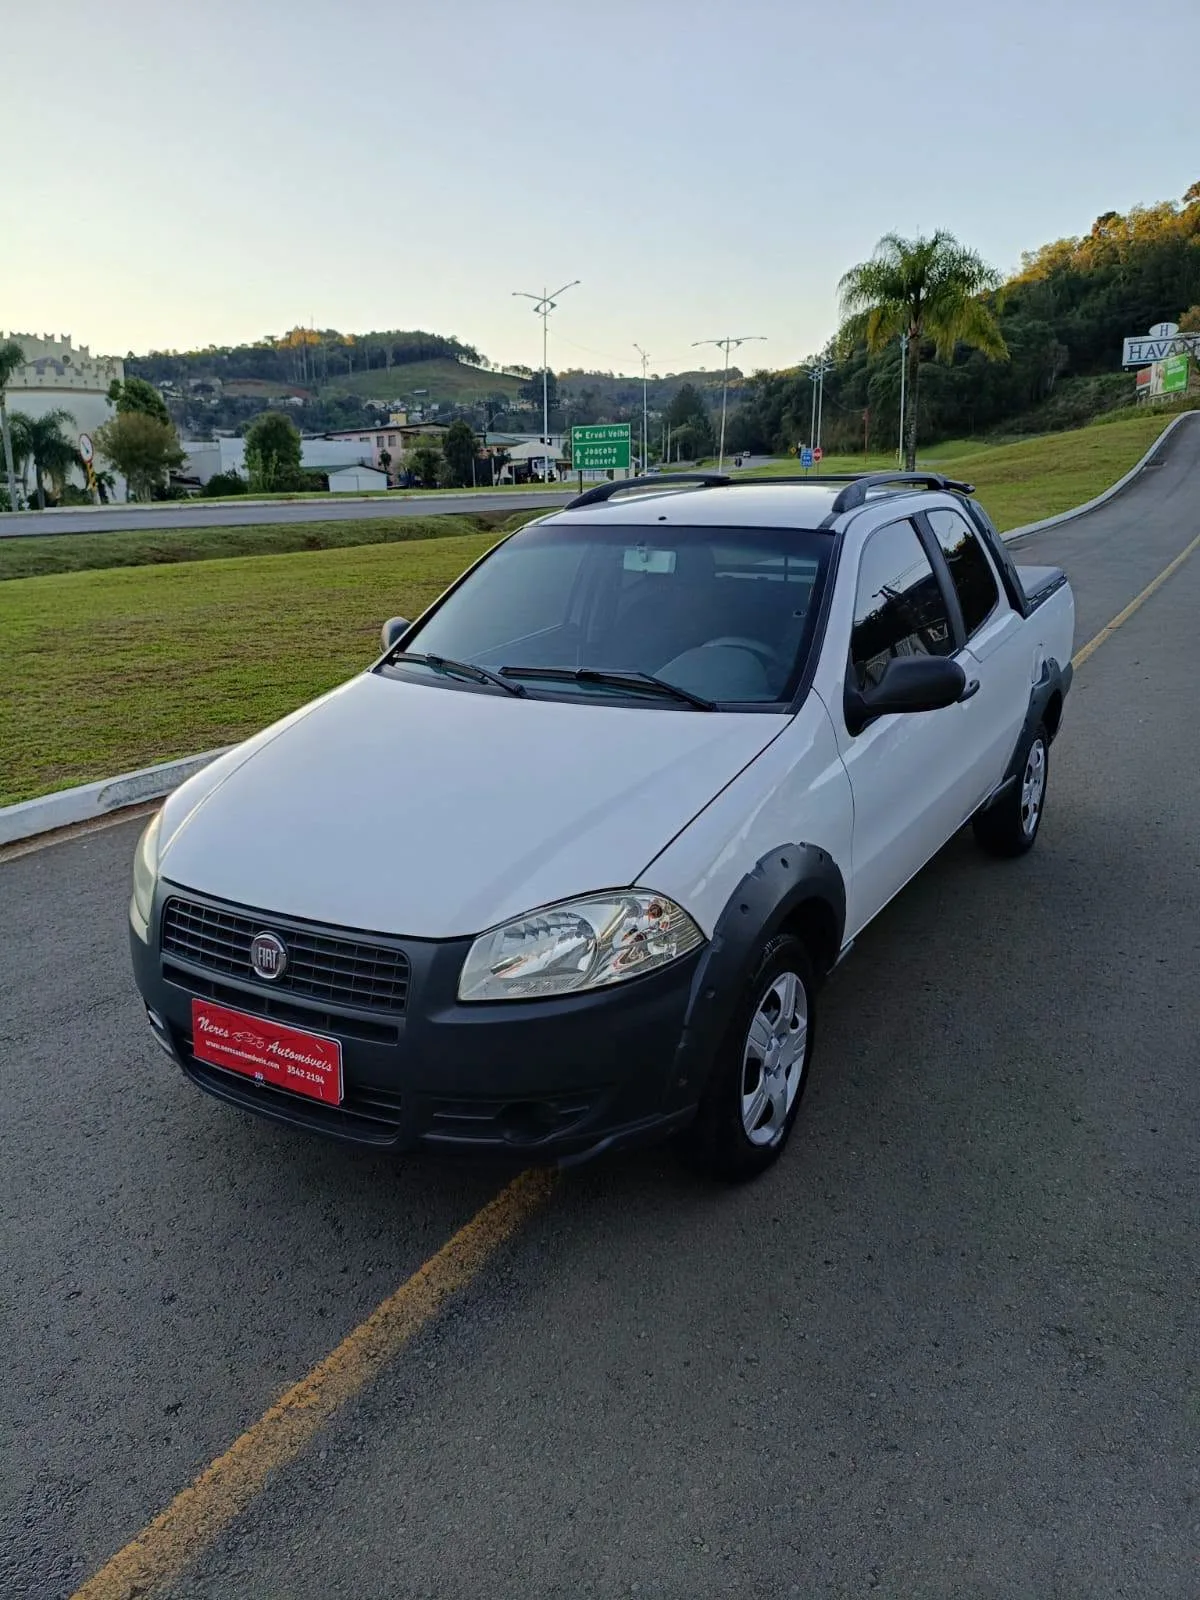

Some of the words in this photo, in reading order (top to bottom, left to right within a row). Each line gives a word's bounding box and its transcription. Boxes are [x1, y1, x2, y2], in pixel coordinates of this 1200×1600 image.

[1160, 324, 1169, 337] H
[585, 431, 606, 439] Erval
[608, 429, 629, 438] Velho
[258, 946, 278, 969] FIAT
[198, 1016, 229, 1038] Neres
[265, 1041, 332, 1072] Automóveis
